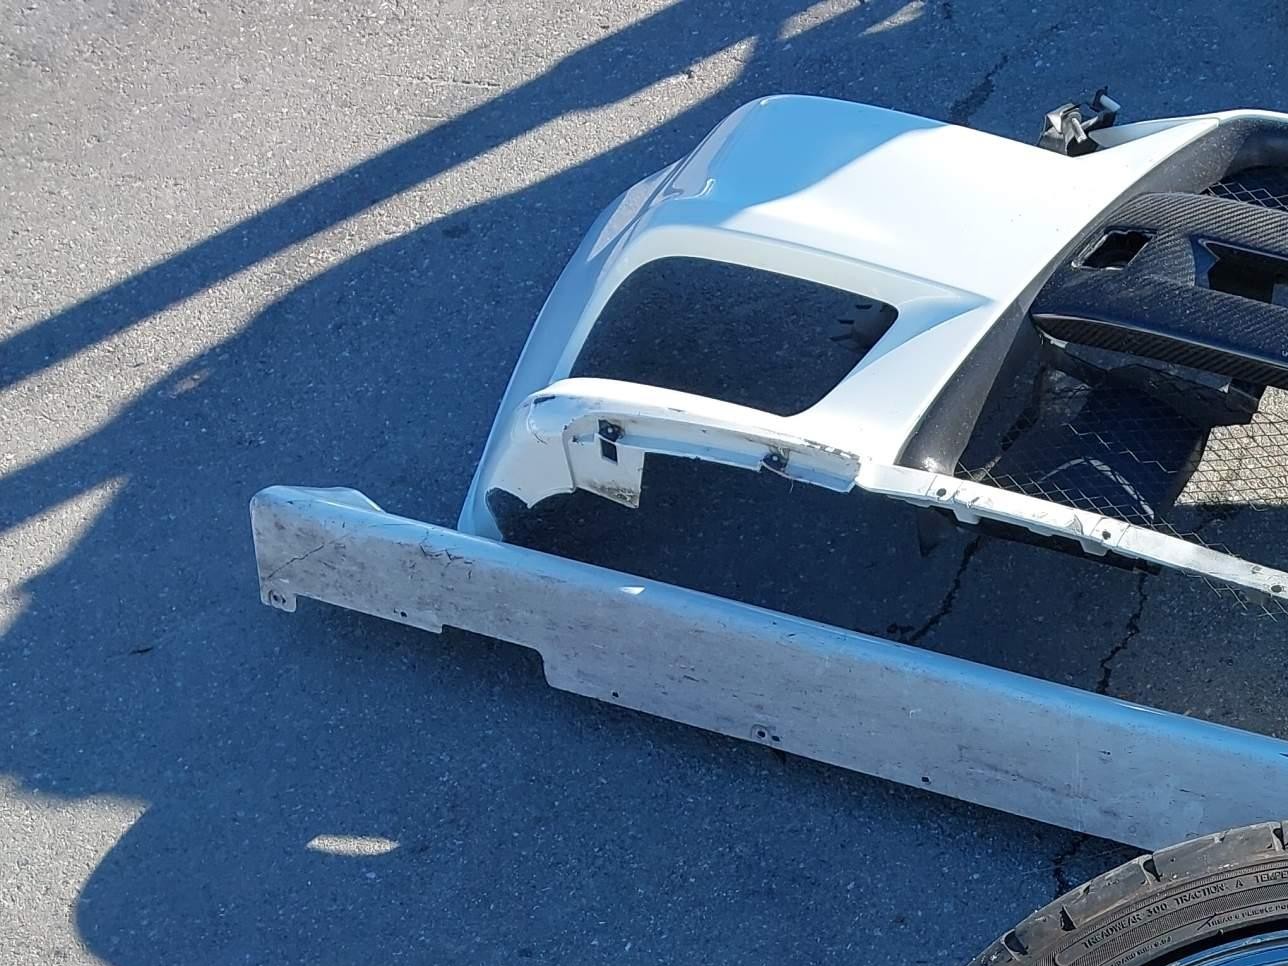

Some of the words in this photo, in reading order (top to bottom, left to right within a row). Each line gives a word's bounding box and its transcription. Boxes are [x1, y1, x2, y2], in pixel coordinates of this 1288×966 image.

[1080, 912, 1142, 950] TREADWEAR
[1145, 900, 1168, 917] 300
[1173, 882, 1224, 906] TRACTION
[1234, 877, 1243, 888] A
